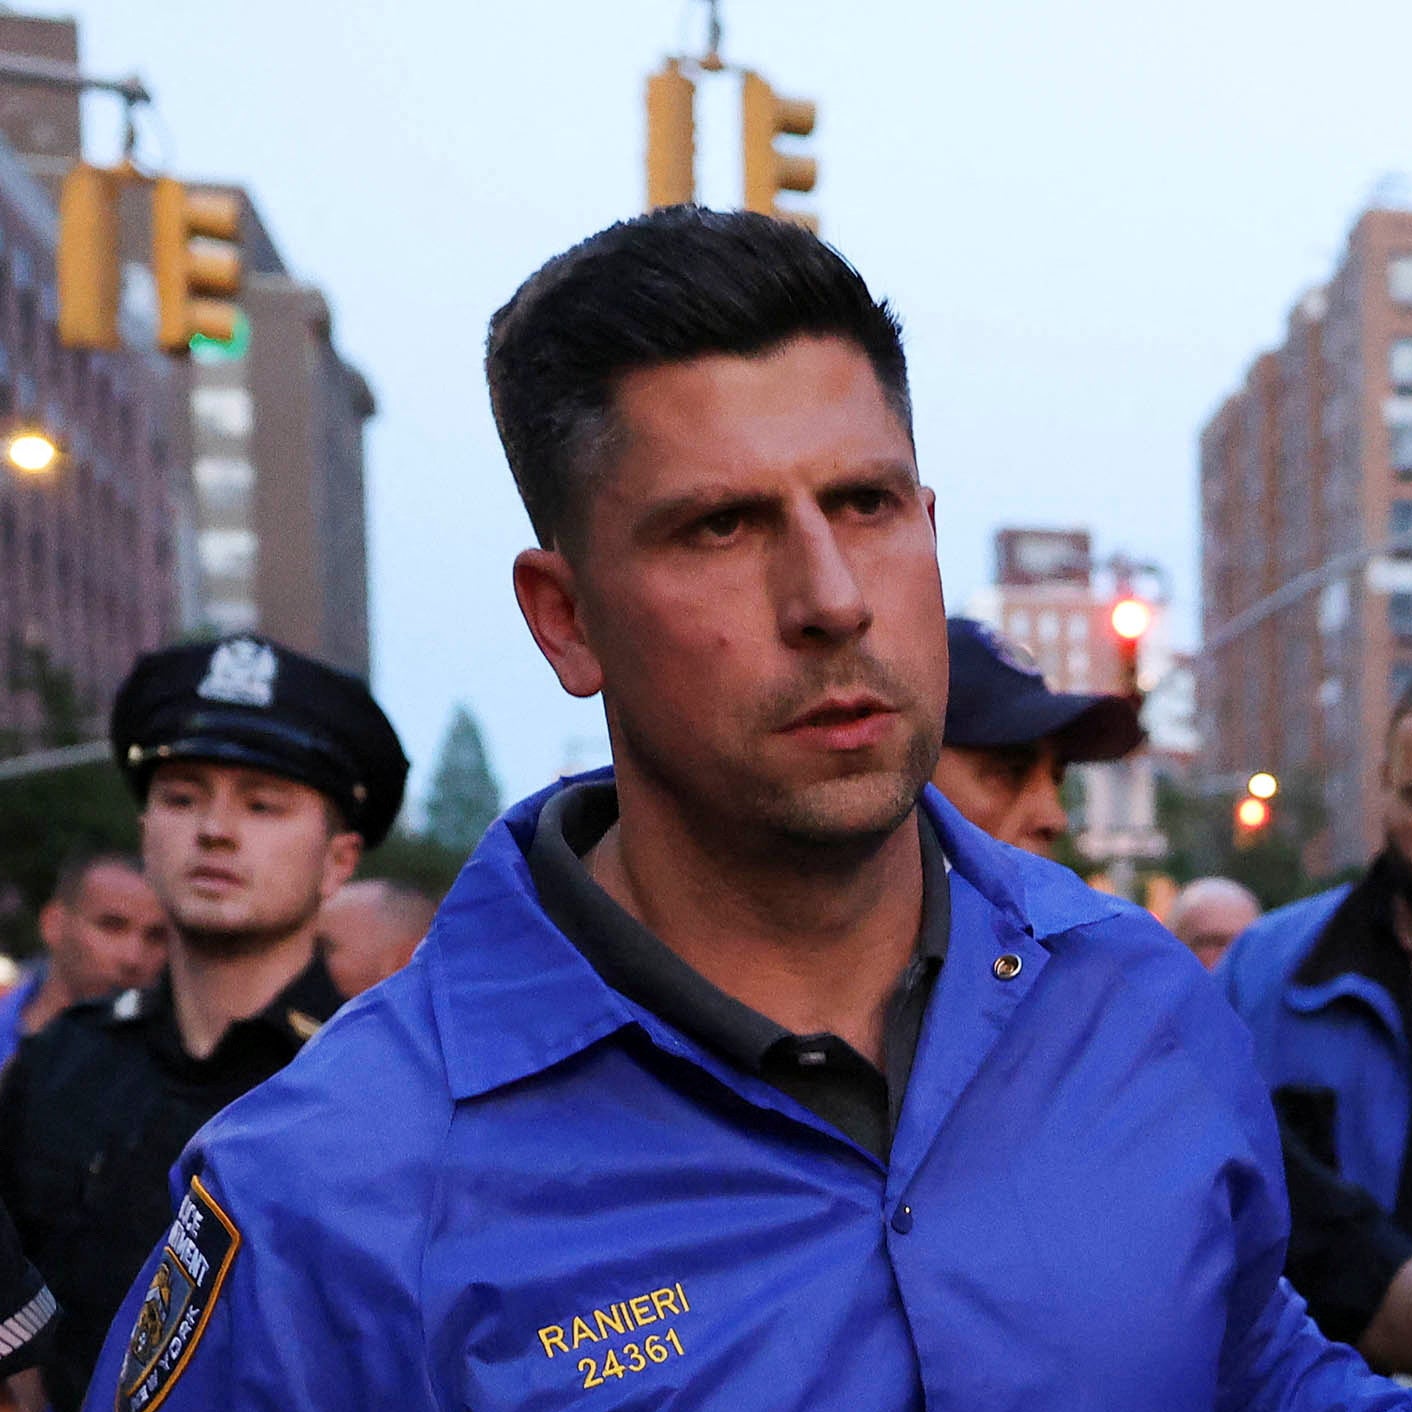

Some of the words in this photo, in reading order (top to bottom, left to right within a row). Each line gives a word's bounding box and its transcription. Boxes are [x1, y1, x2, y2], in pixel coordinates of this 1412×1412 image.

[159, 1304, 200, 1371] YORK
[537, 1282, 691, 1358] RANIERI
[577, 1328, 686, 1390] 24361
